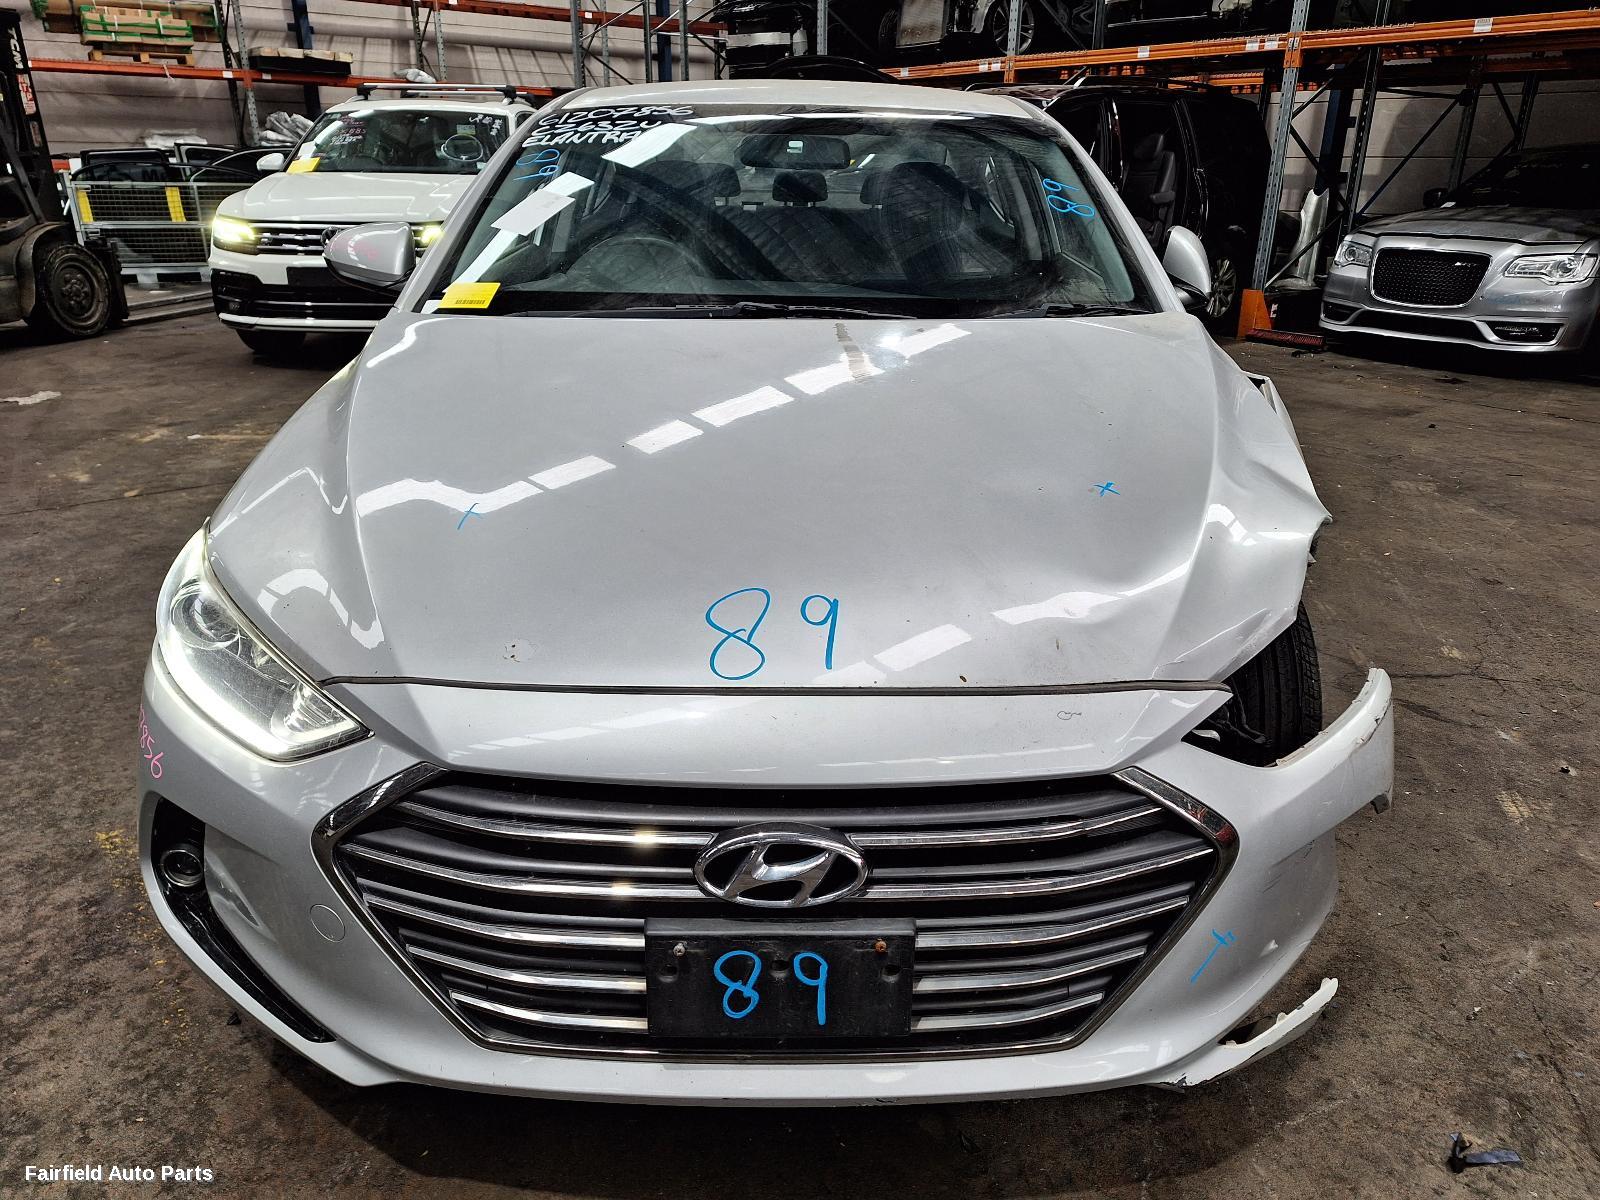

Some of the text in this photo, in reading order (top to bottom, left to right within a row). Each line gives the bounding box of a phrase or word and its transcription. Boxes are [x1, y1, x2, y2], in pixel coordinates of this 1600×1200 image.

[8, 27, 24, 69] TCM
[538, 105, 694, 126] 61207856
[521, 130, 642, 148] ELANTRA
[705, 587, 839, 681] 89
[713, 950, 829, 1026] 89
